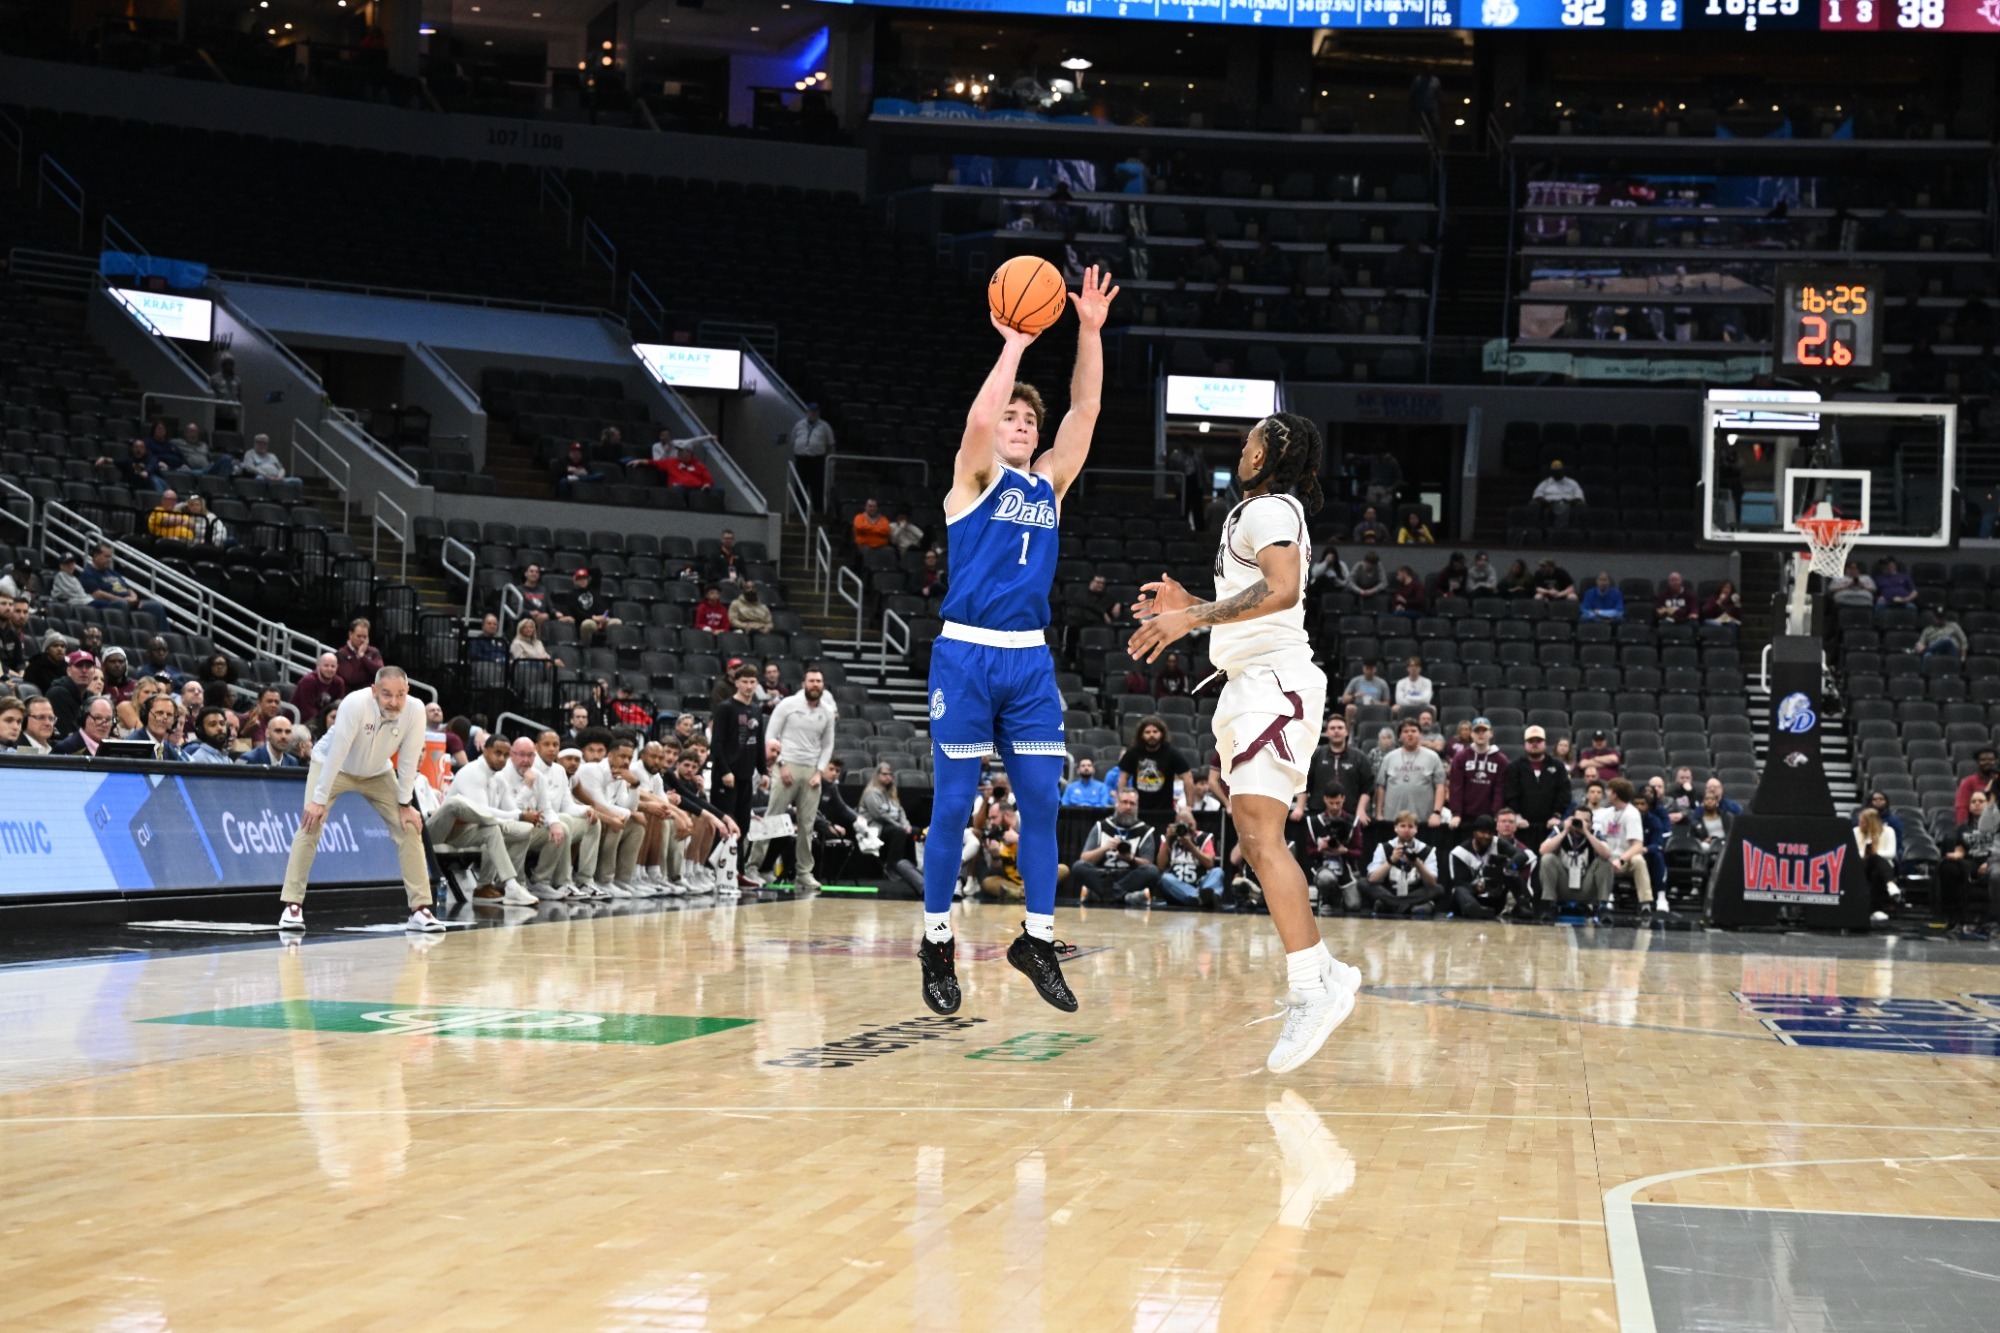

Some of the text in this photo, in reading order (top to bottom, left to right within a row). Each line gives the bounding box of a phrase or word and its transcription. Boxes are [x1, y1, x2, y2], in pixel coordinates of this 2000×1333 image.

[1561, 0, 1606, 26] 32
[1897, 0, 1945, 28] 38
[1803, 285, 1867, 315] 16:25
[1797, 315, 1852, 366] 2.6
[991, 488, 1055, 529] Drake
[1018, 531, 1030, 565] 1
[1465, 760, 1498, 773] SIU
[222, 808, 292, 855] Credit
[1777, 842, 1808, 855] THE
[1173, 864, 1197, 883] 35
[1742, 839, 1847, 894] VALLEY
[762, 1016, 988, 1068] enterprise
